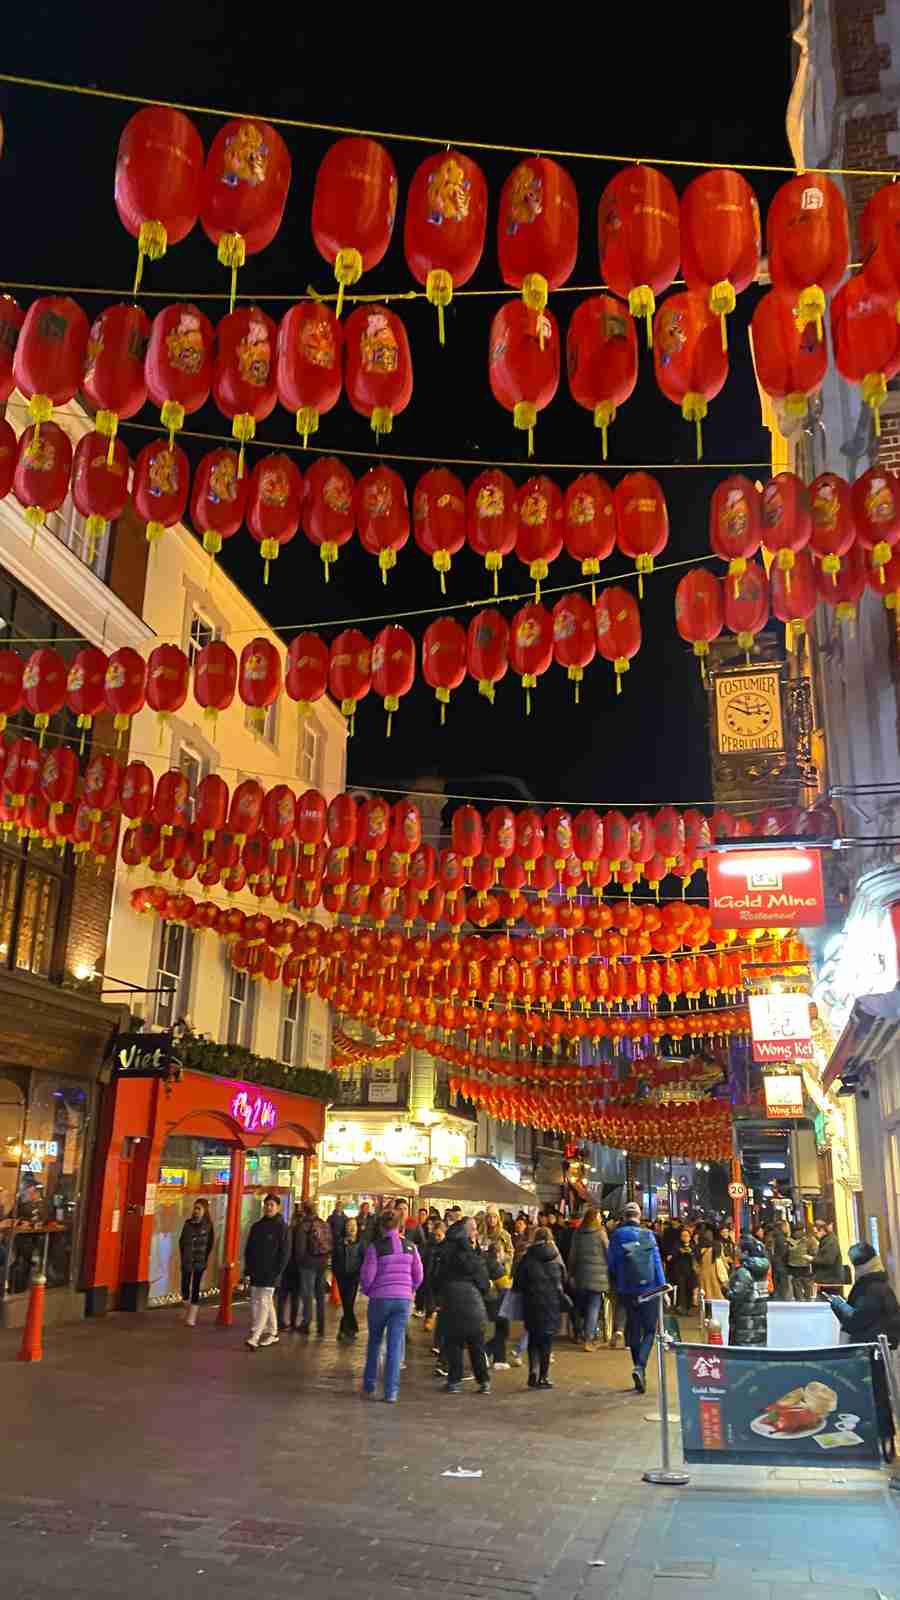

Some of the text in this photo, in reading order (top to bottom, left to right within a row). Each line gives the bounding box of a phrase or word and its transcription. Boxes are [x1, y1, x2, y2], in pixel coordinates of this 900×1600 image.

[718, 676, 777, 698] COSTUMIER
[118, 1044, 163, 1070] Viet
[757, 1041, 813, 1058] Wong Kei
[731, 1186, 744, 1195] 20
